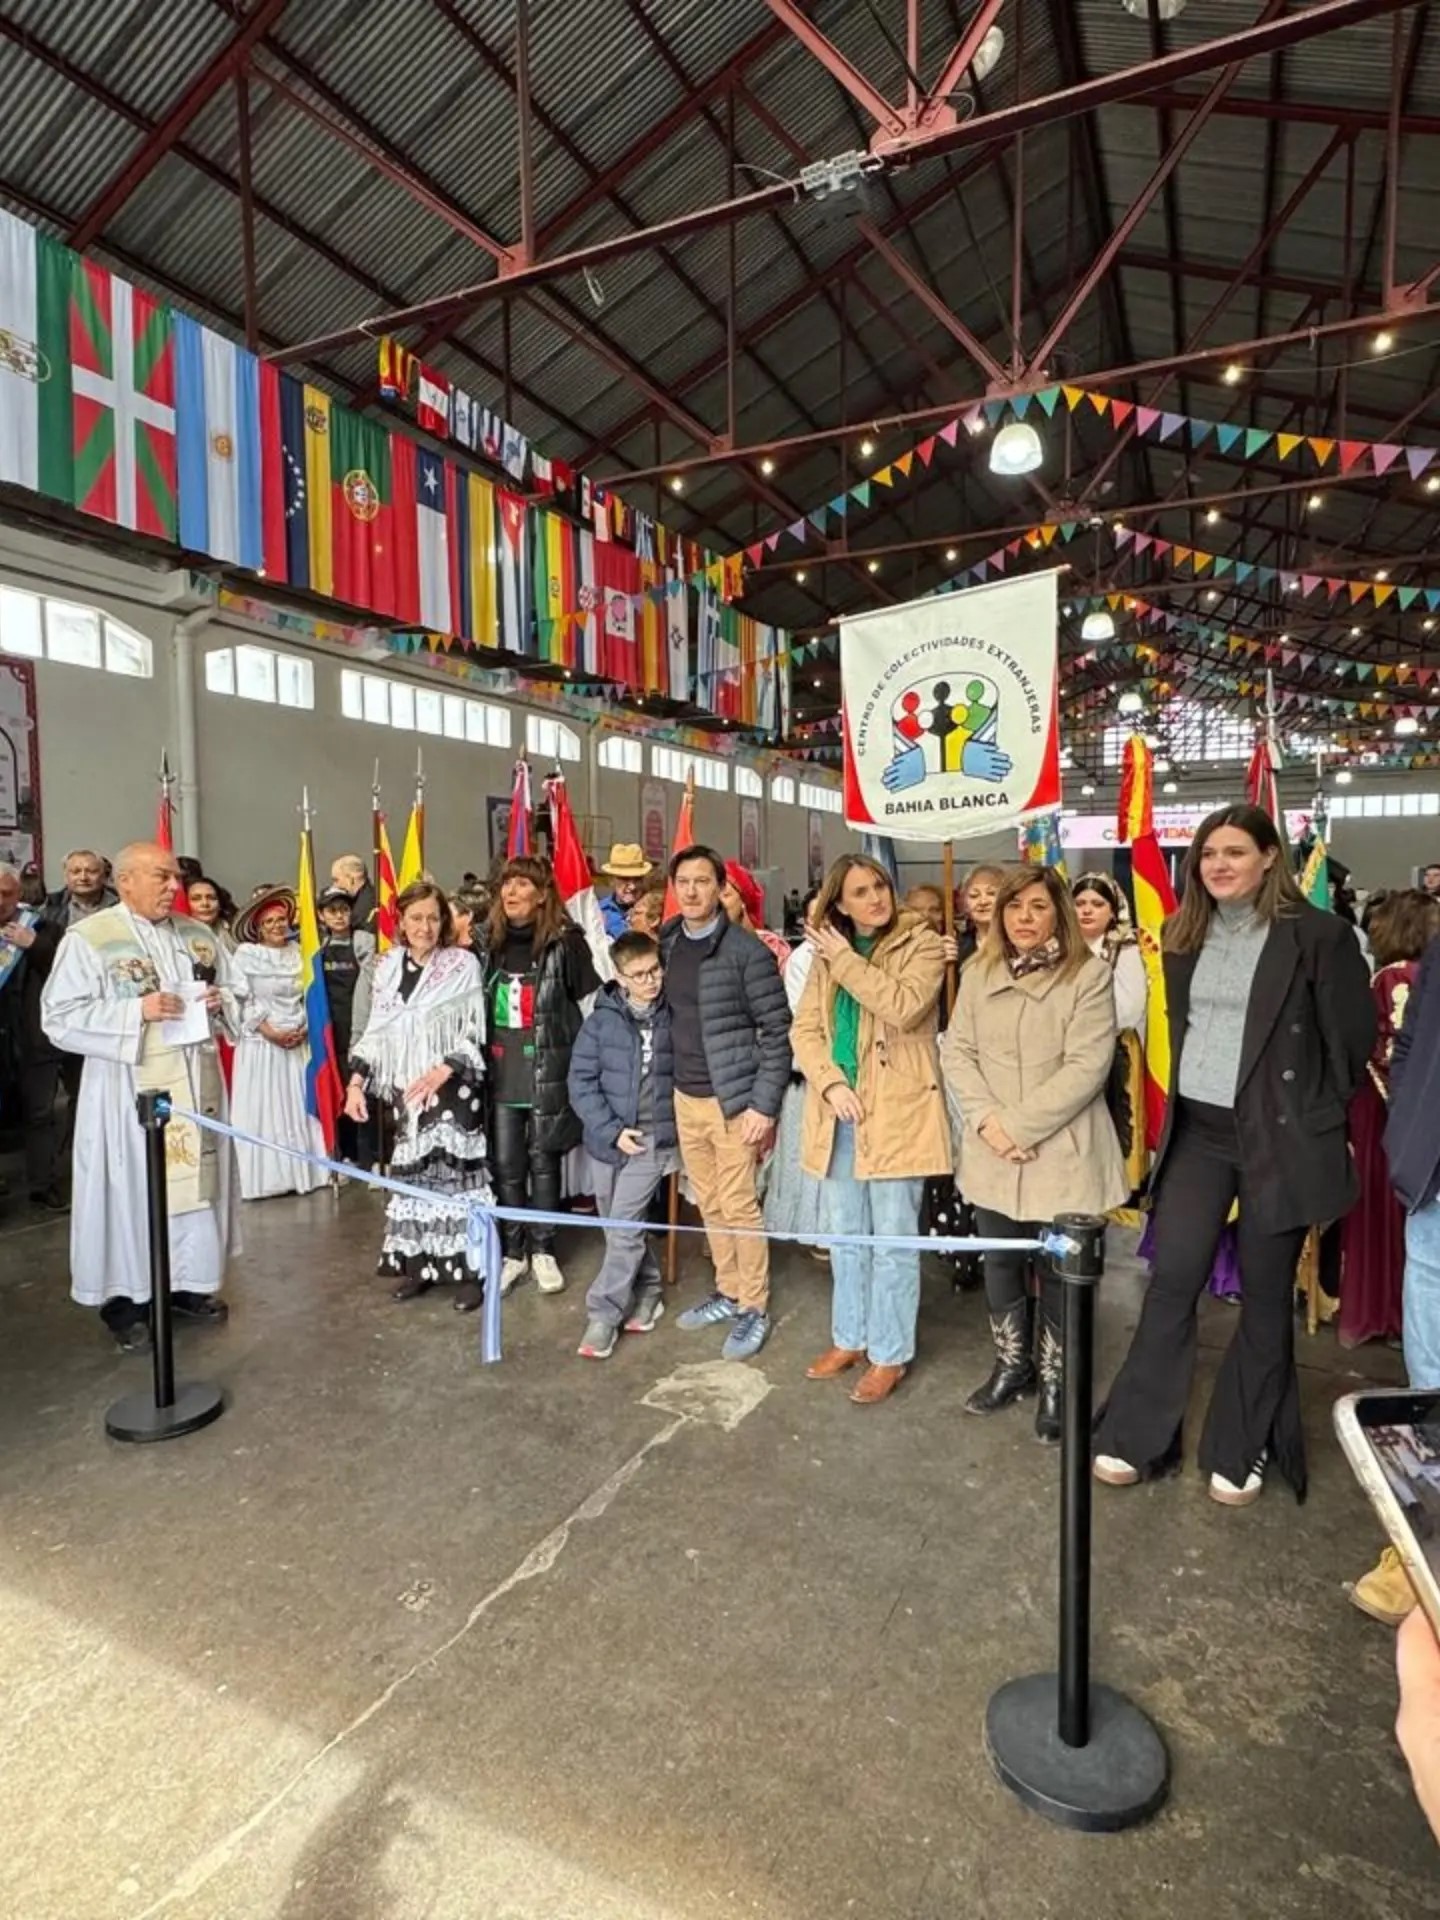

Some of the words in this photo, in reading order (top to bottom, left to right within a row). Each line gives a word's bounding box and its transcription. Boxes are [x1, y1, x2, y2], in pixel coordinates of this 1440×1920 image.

[857, 701, 875, 757] CENTRO
[872, 682, 885, 699] DE
[883, 635, 985, 681] COLECTIVIDADES
[987, 643, 1042, 734] EXTRANJERAS
[885, 799, 934, 815] BAHIA
[939, 792, 1009, 810] BLANCA
